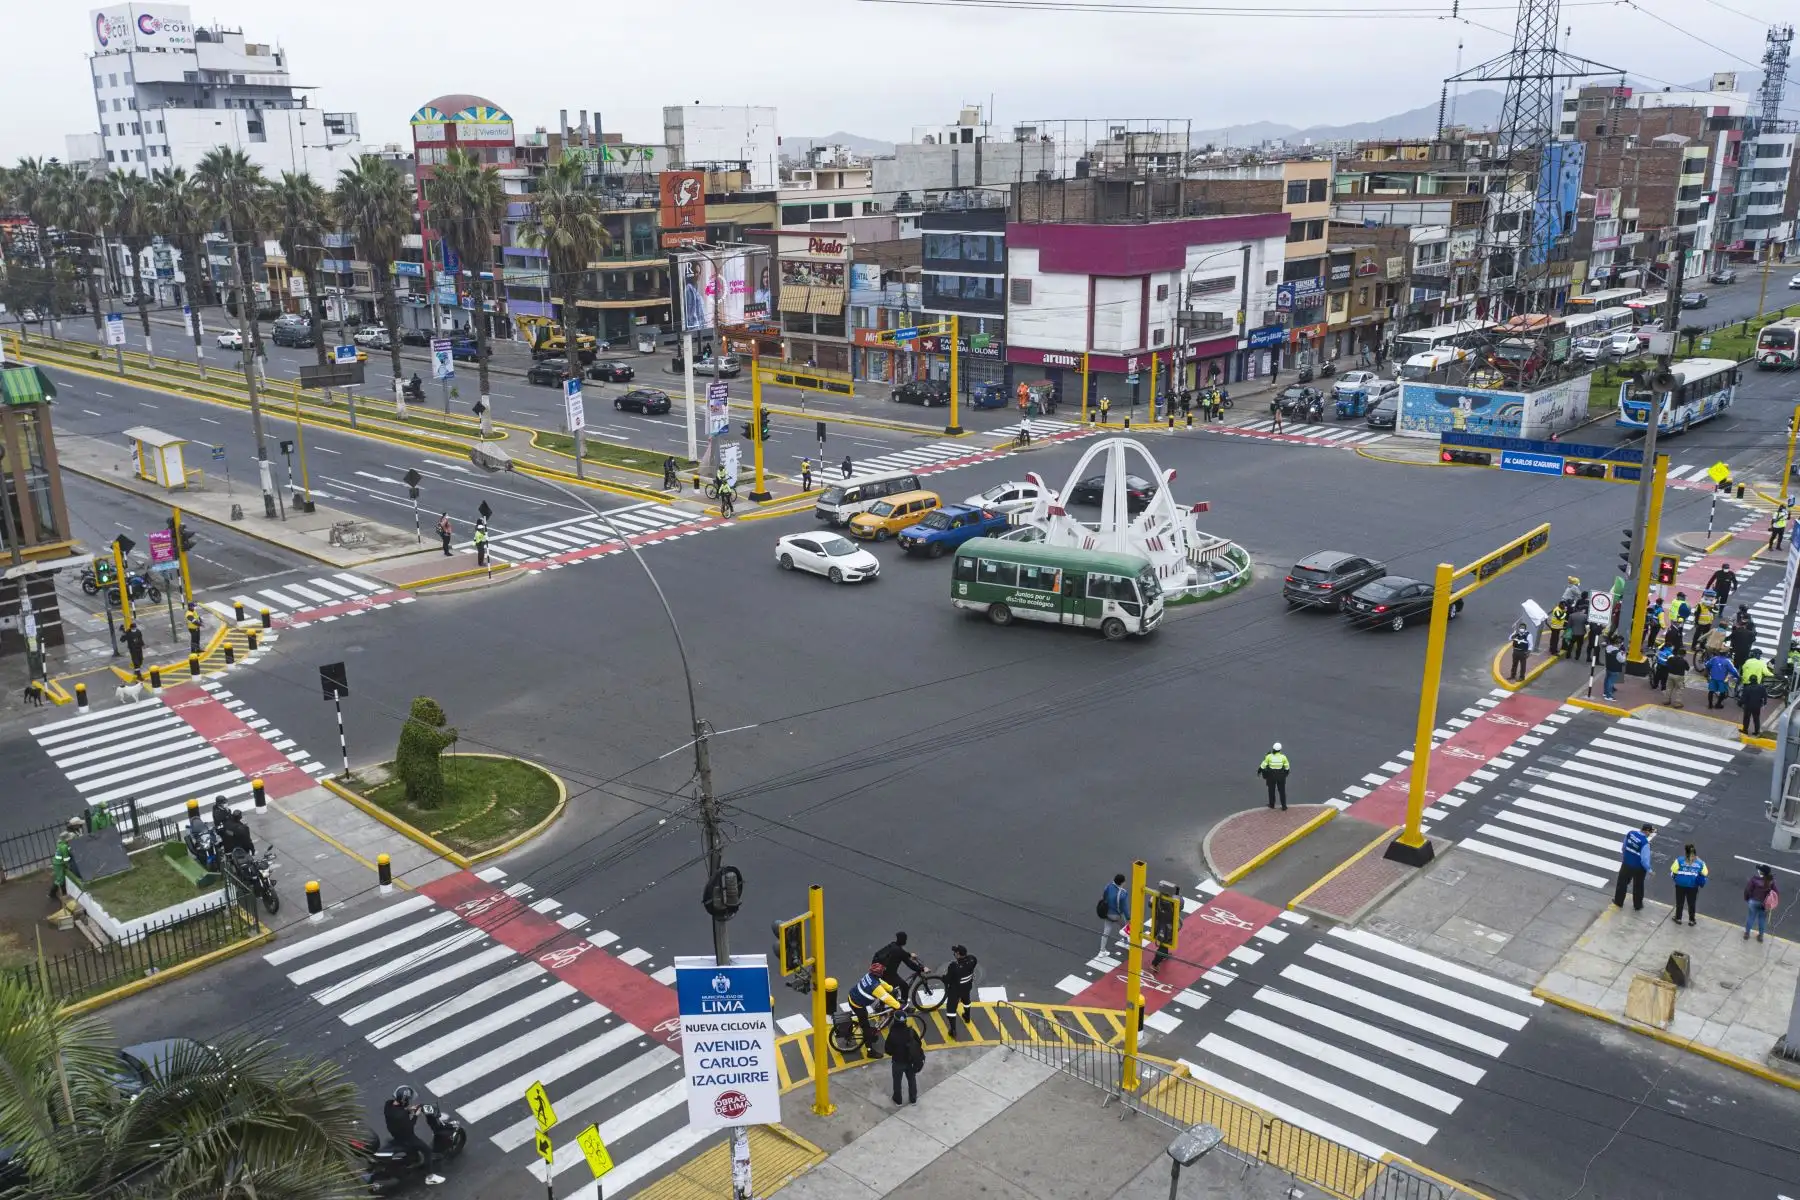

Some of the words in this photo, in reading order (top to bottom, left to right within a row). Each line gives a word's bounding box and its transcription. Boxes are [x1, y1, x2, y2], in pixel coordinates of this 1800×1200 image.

[163, 24, 191, 32] CORI
[808, 237, 843, 254] Pikalo
[1544, 443, 1560, 453] DE
[1570, 445, 1594, 457] LOS
[1512, 458, 1532, 466] CARLOS
[1533, 460, 1560, 470] IZAGUIRRE
[1005, 596, 1027, 604] distrito
[1015, 590, 1035, 599] Juntos
[702, 1000, 746, 1013] LIMA
[685, 1023, 719, 1033] NUEVA
[720, 1019, 767, 1032] CICLOVÍA
[693, 1039, 762, 1053] AVENIDA
[699, 1055, 759, 1069] CARLOS
[692, 1071, 769, 1087] IZAGUIRRE
[714, 1095, 747, 1108] OBRAS
[715, 1105, 729, 1115] DE
[728, 1100, 752, 1112] LIMA
